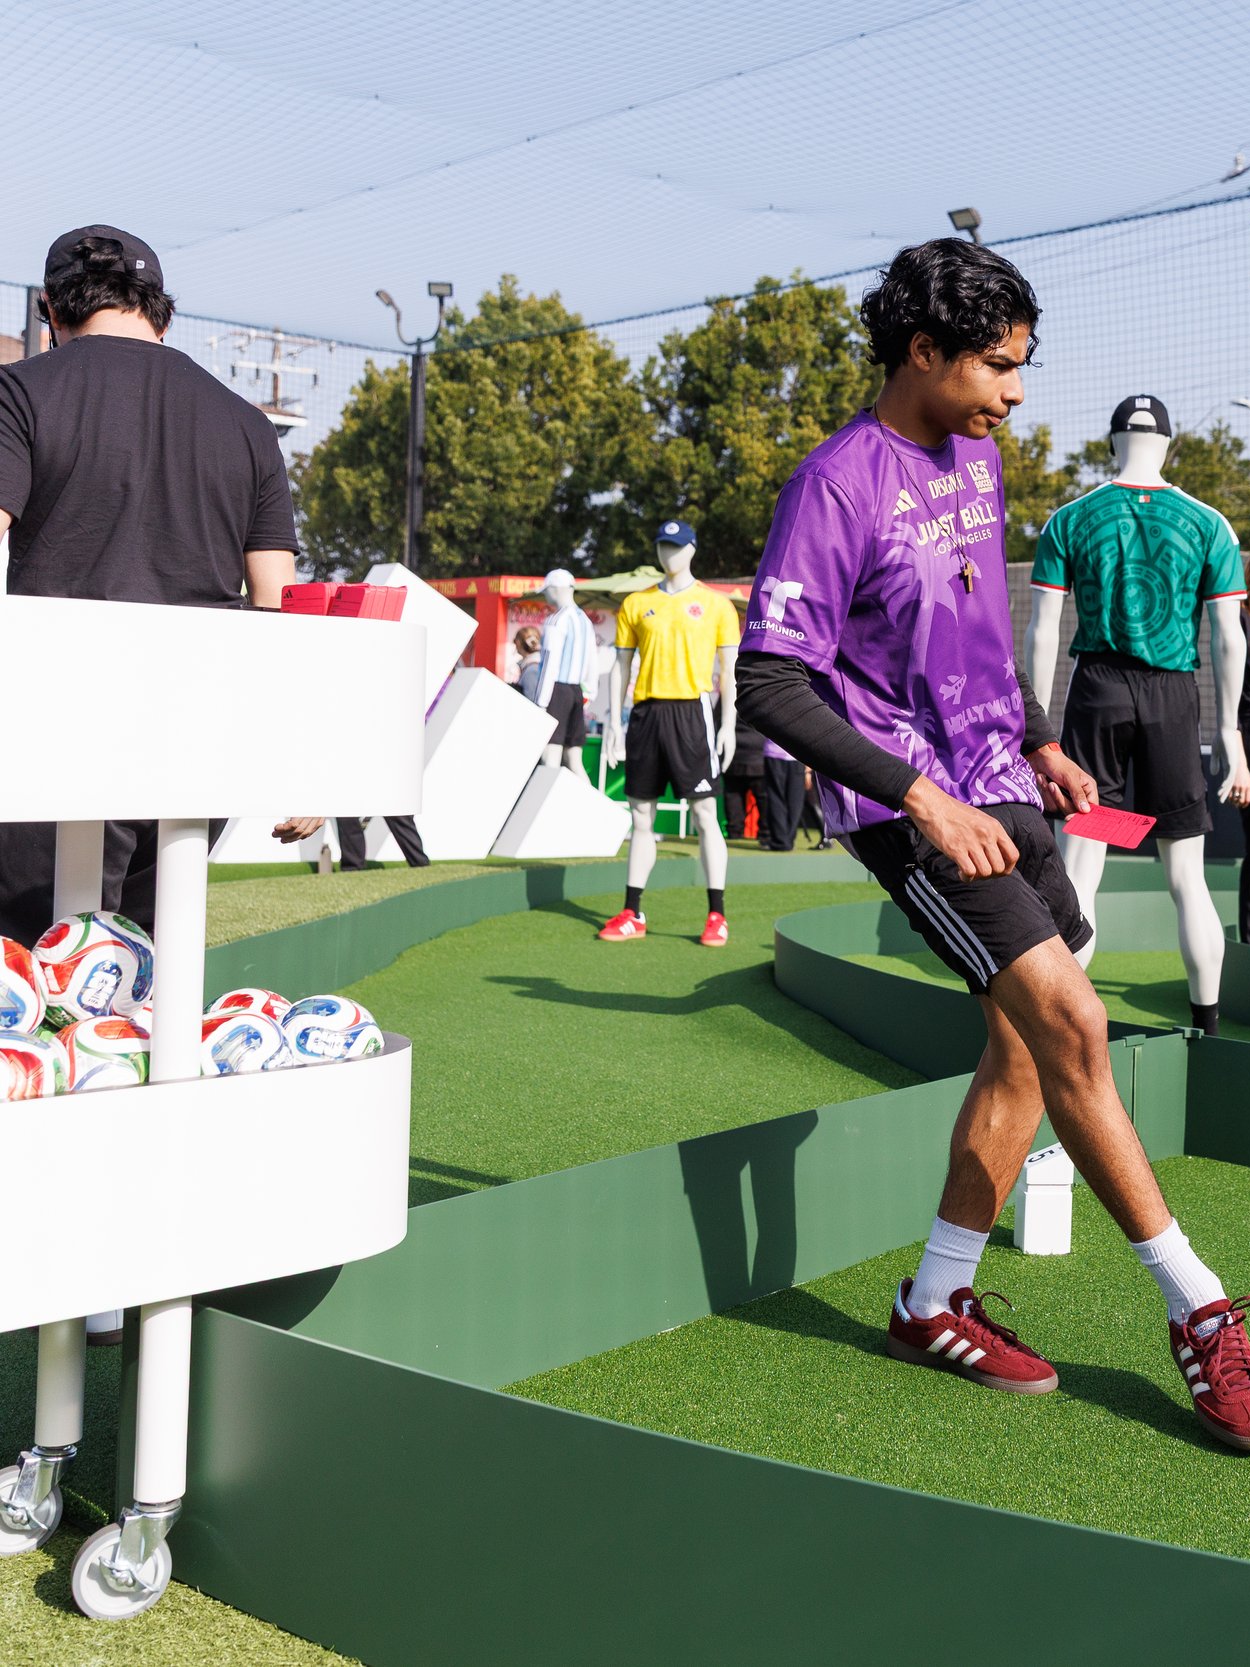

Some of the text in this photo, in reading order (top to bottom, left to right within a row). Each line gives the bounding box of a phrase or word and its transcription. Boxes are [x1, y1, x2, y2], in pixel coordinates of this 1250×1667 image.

[917, 503, 998, 546] JUST BALL
[933, 527, 993, 557] LOS ANGELES
[749, 620, 805, 640] TELEMUNDO
